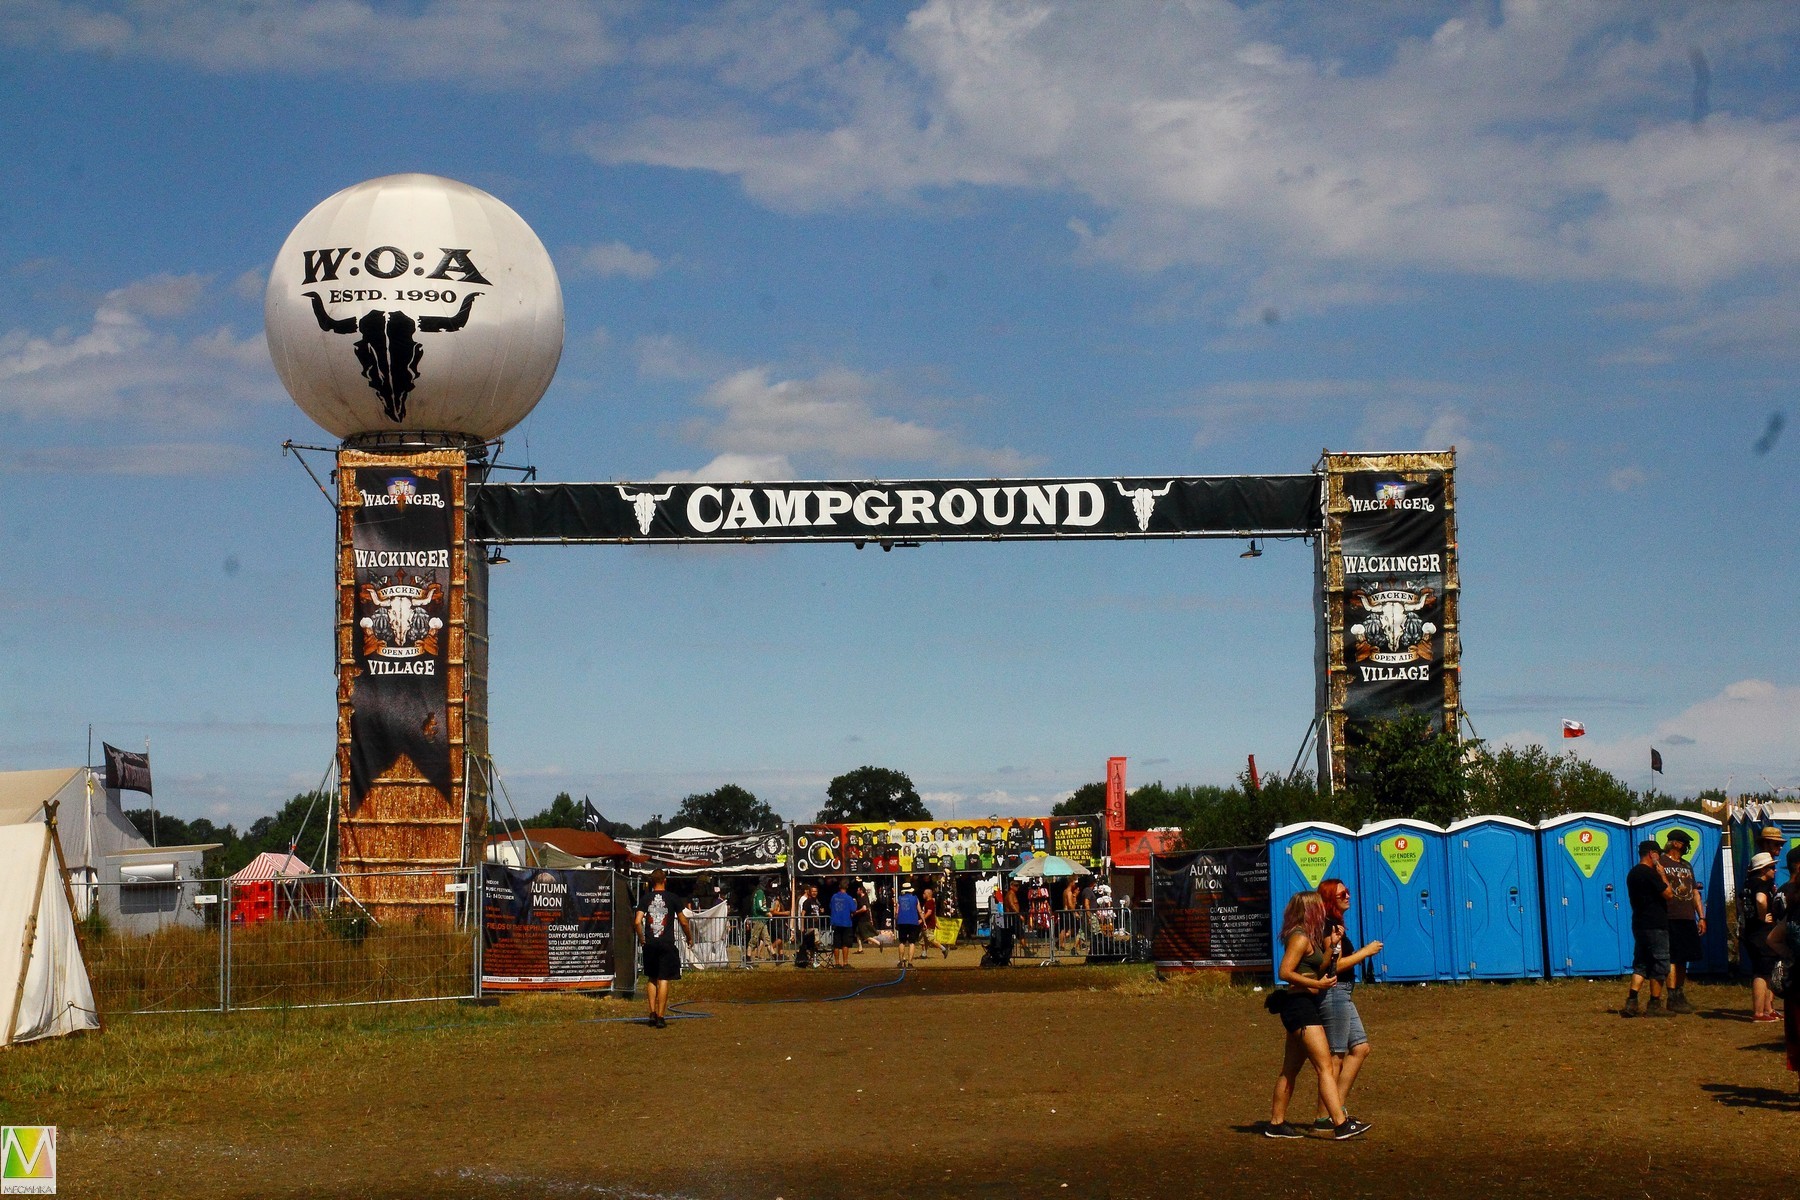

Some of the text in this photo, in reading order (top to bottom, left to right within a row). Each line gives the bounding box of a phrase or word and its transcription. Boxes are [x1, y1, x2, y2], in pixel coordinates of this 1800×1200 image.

[301, 245, 493, 286] W:O:A
[329, 289, 457, 304] ESTD. 1990
[686, 482, 1105, 533] CAMPGROUND
[354, 549, 449, 568] WACKINGER
[1342, 554, 1441, 574] WACKINGER
[380, 585, 422, 597] WACKEN
[1371, 590, 1414, 601] WACKEN
[381, 647, 420, 656] OPEN AIR
[1374, 652, 1414, 662] OPEN AIR
[368, 659, 435, 676] VILLAGE
[1360, 665, 1430, 682] VILLAGE
[1054, 827, 1092, 836] CAMPING
[1189, 864, 1228, 876] AUTUMN
[530, 881, 568, 894] AUTUMN
[1196, 878, 1223, 890] MOON
[533, 894, 562, 907] MOON
[548, 924, 579, 932] COVENANT
